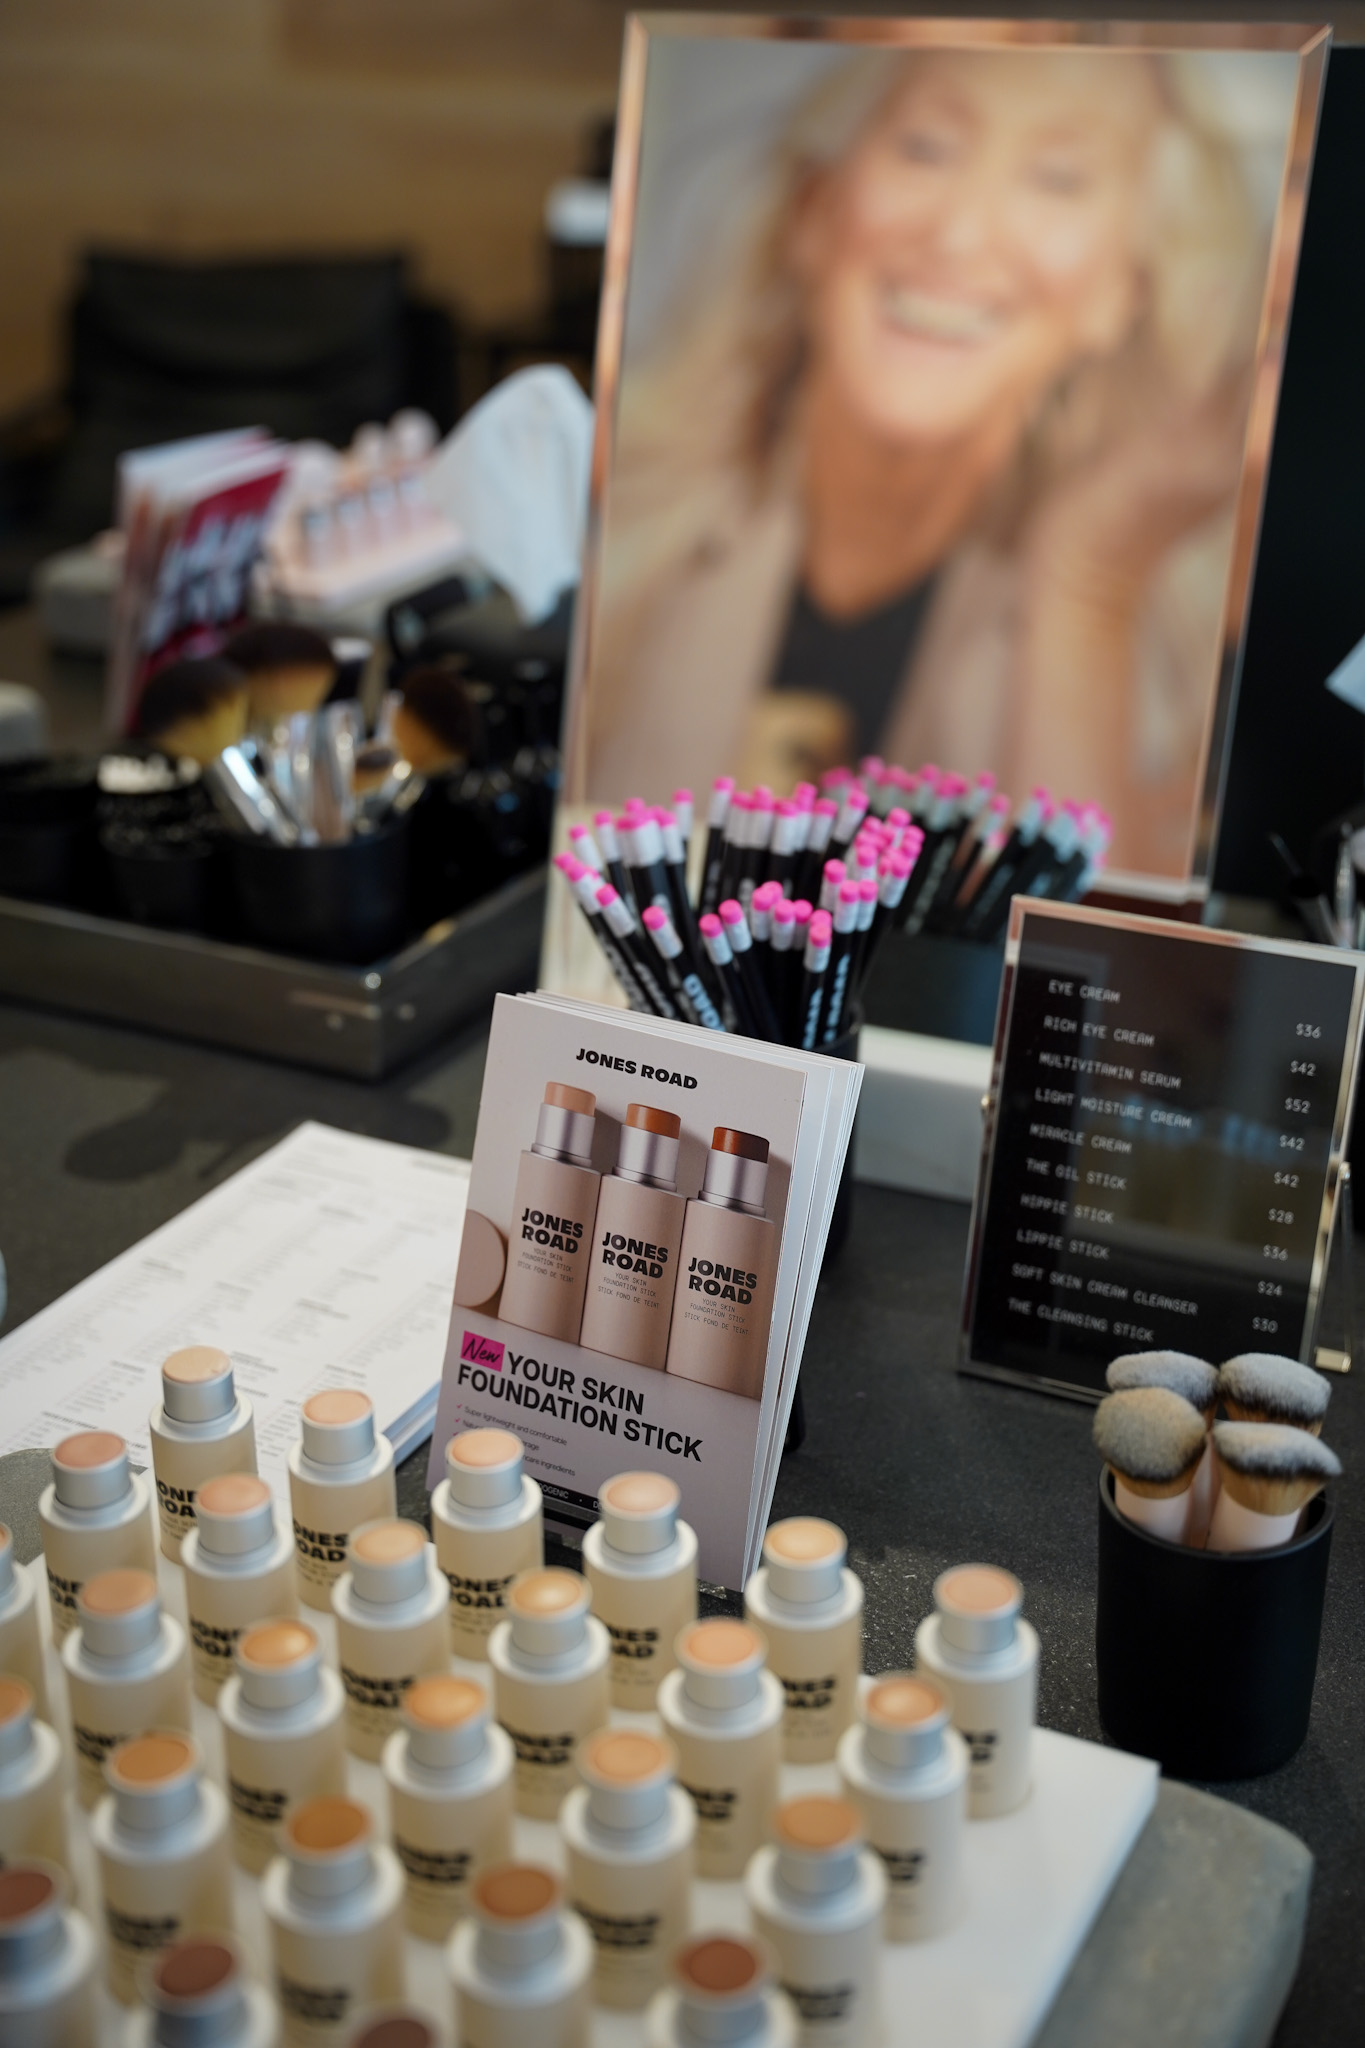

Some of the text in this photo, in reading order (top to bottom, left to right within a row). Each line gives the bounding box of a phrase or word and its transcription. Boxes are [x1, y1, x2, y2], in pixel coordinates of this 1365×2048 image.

[1048, 979, 1121, 1004] EYE CREAM
[1043, 1015, 1155, 1047] RICH EYE CREAM
[1295, 1022, 1322, 1039] $36
[576, 1048, 698, 1089] JONES ROAD
[1039, 1051, 1182, 1090] MULTIVITAMIN SERUM
[1290, 1060, 1316, 1077] $42
[1034, 1087, 1193, 1129] LIGHT MOISTURE CREAM
[1284, 1097, 1311, 1114] $52
[1029, 1122, 1133, 1154] MIRACLE CREAM
[1279, 1134, 1305, 1151] $42
[1026, 1157, 1127, 1191] THE OIL STICK
[1273, 1171, 1299, 1188] $42
[522, 1208, 584, 1239] JONES
[1074, 1204, 1114, 1225] STICK
[1268, 1208, 1294, 1225] $28
[522, 1224, 578, 1254] ROAD
[602, 1232, 669, 1263] JONES
[1069, 1239, 1110, 1261] STICK
[1263, 1244, 1288, 1261] $36
[602, 1249, 663, 1279] ROAD
[688, 1257, 758, 1289] JONES
[688, 1274, 752, 1305] ROAD
[1011, 1262, 1199, 1316] SOFT SKIN CREAM CLEANSER
[1257, 1280, 1283, 1297] $24
[1008, 1296, 1154, 1343] THE CLEANSING STICK
[1252, 1316, 1278, 1334] $30
[463, 1338, 645, 1416] New YOUR SKIN
[457, 1363, 704, 1463] FOUNDATION STICK
[464, 1405, 567, 1446] Super lightweight and comfortable
[540, 1458, 576, 1477] ingredients
